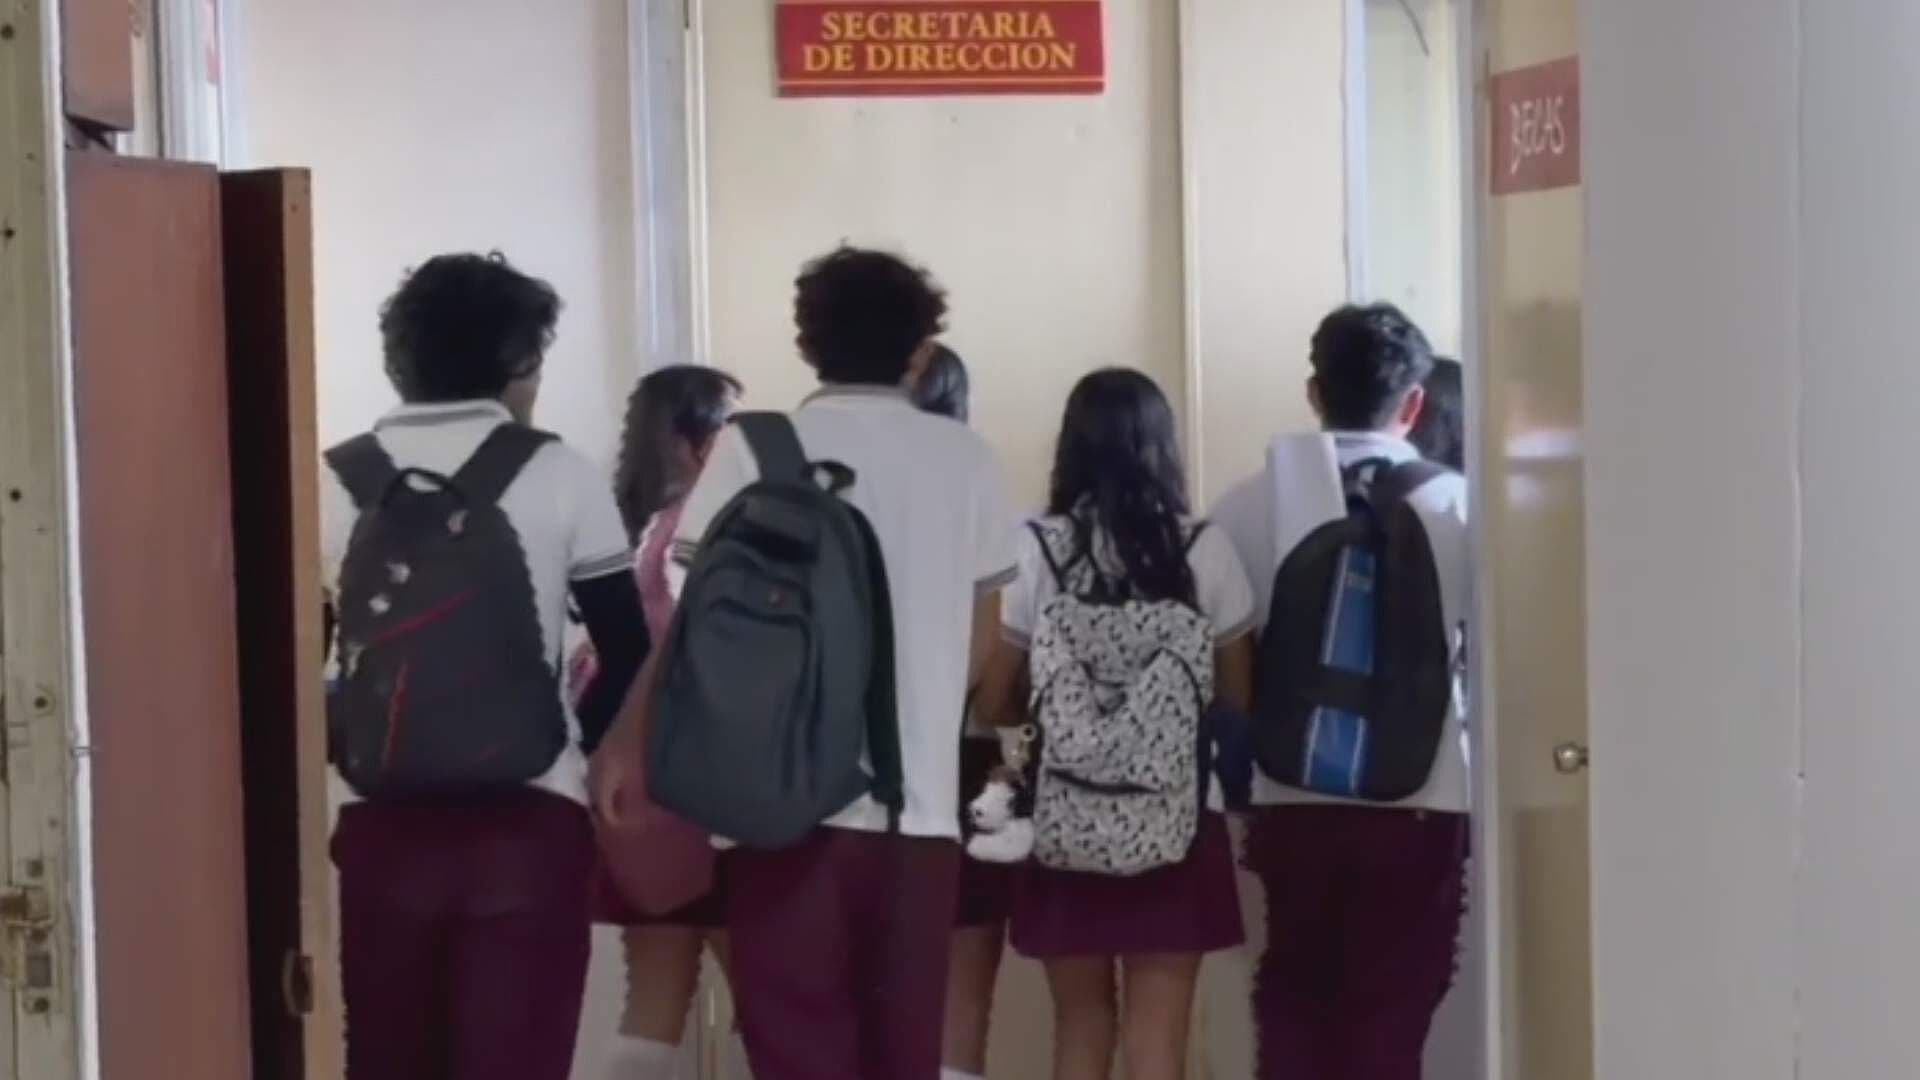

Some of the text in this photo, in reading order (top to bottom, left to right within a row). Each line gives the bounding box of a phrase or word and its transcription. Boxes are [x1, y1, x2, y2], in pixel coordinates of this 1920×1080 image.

[822, 11, 1054, 41] SECRETARIA
[804, 42, 1077, 72] DE DIRECCION
